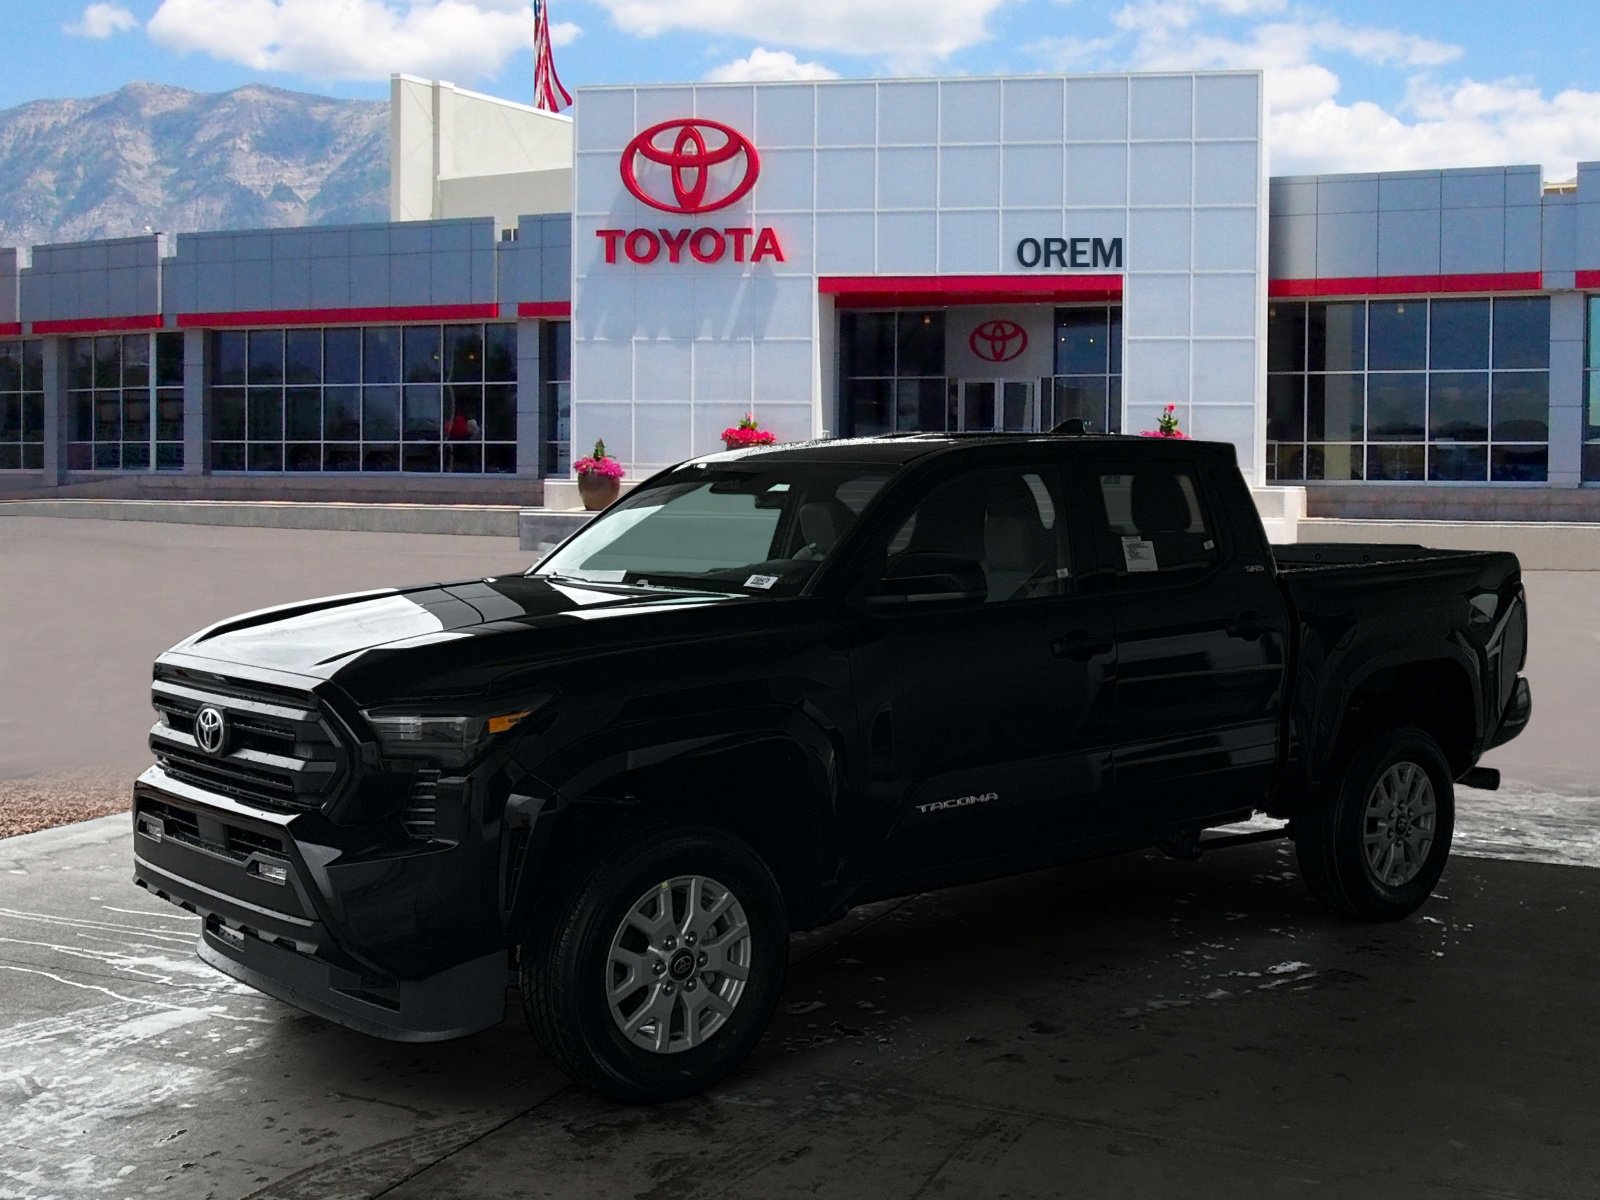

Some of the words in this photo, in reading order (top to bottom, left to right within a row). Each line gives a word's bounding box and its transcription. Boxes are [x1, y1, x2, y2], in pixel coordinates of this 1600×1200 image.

[596, 227, 785, 264] TOYOTA
[1017, 237, 1123, 268] OREM
[915, 792, 999, 813] TACOMA
